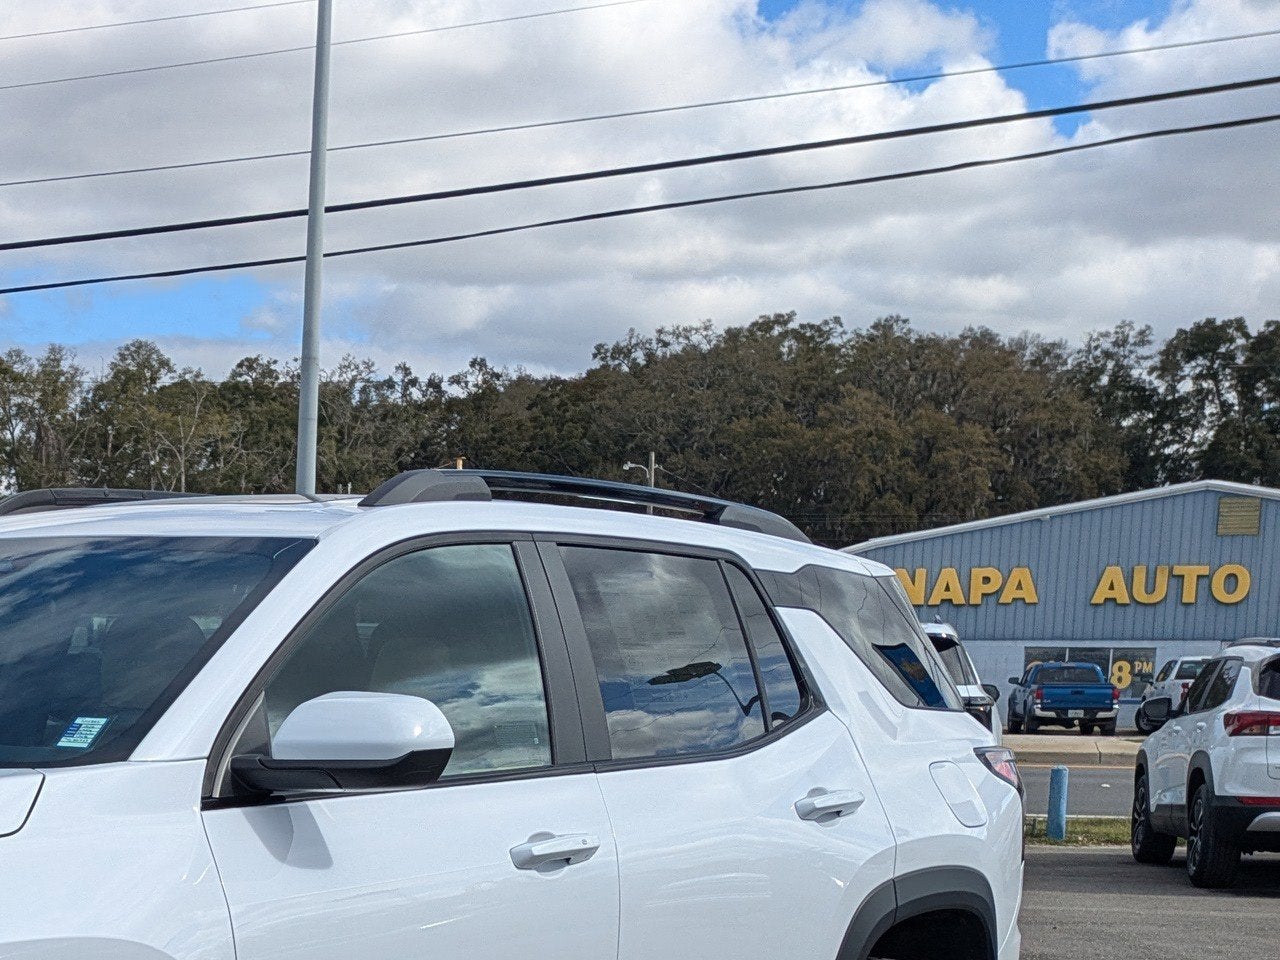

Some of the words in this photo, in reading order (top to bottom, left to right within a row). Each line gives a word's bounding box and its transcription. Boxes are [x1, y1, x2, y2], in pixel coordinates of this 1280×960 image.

[893, 566, 1039, 606] NAPA
[1091, 564, 1251, 605] AUTO
[1110, 660, 1132, 689] 8
[1134, 661, 1153, 673] PM
